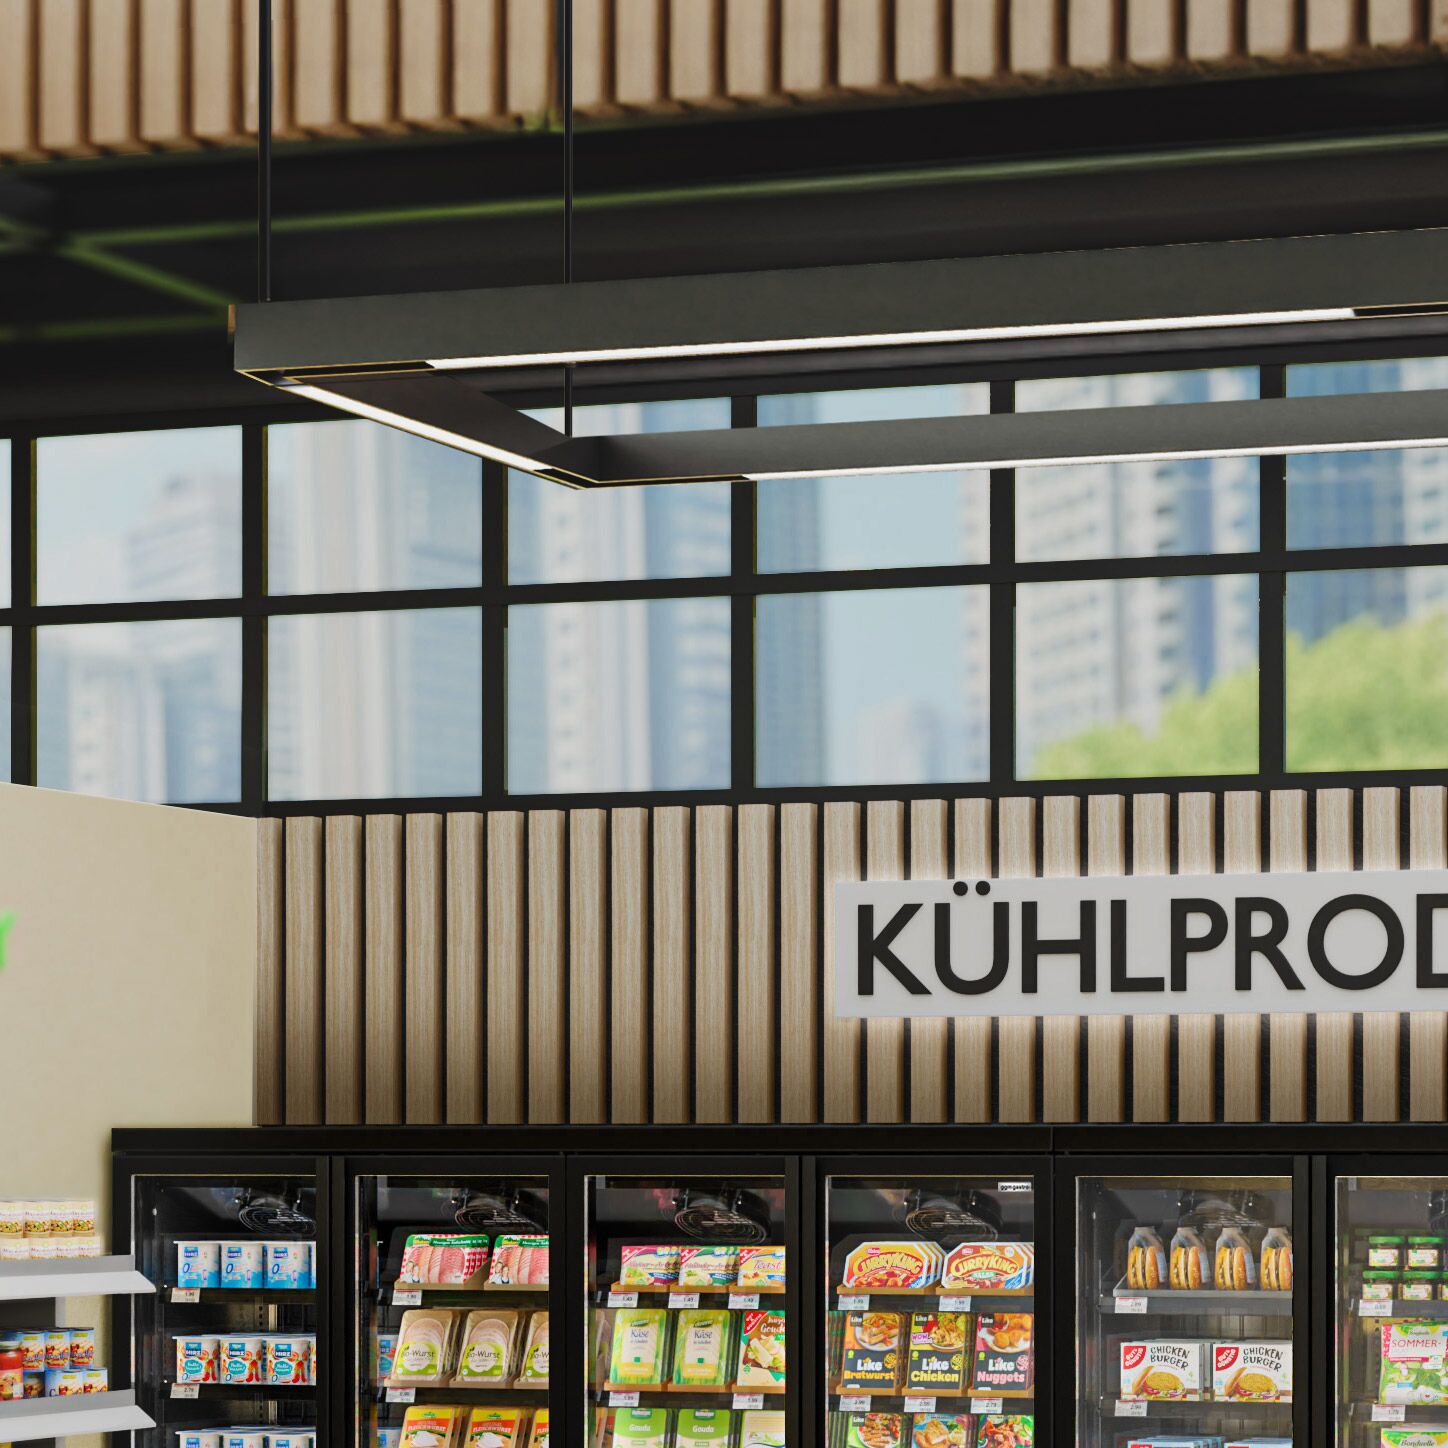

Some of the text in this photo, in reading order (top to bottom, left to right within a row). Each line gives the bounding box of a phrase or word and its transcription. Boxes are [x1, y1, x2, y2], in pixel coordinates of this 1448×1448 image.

[1391, 1338, 1442, 1348] SOMMER-
[1150, 1345, 1190, 1360] CHICKEN
[1243, 1346, 1284, 1362] CHICKEN
[856, 1357, 883, 1371] Like
[921, 1357, 950, 1372] Like
[988, 1357, 1015, 1372] Like
[1150, 1355, 1189, 1371] BURGER
[1242, 1356, 1283, 1373] BURGER
[844, 1371, 896, 1380] Bratwurst
[910, 1370, 959, 1382] Chicken
[976, 1371, 1025, 1385] Nuggets
[1400, 1439, 1436, 1448] Bonduelle
